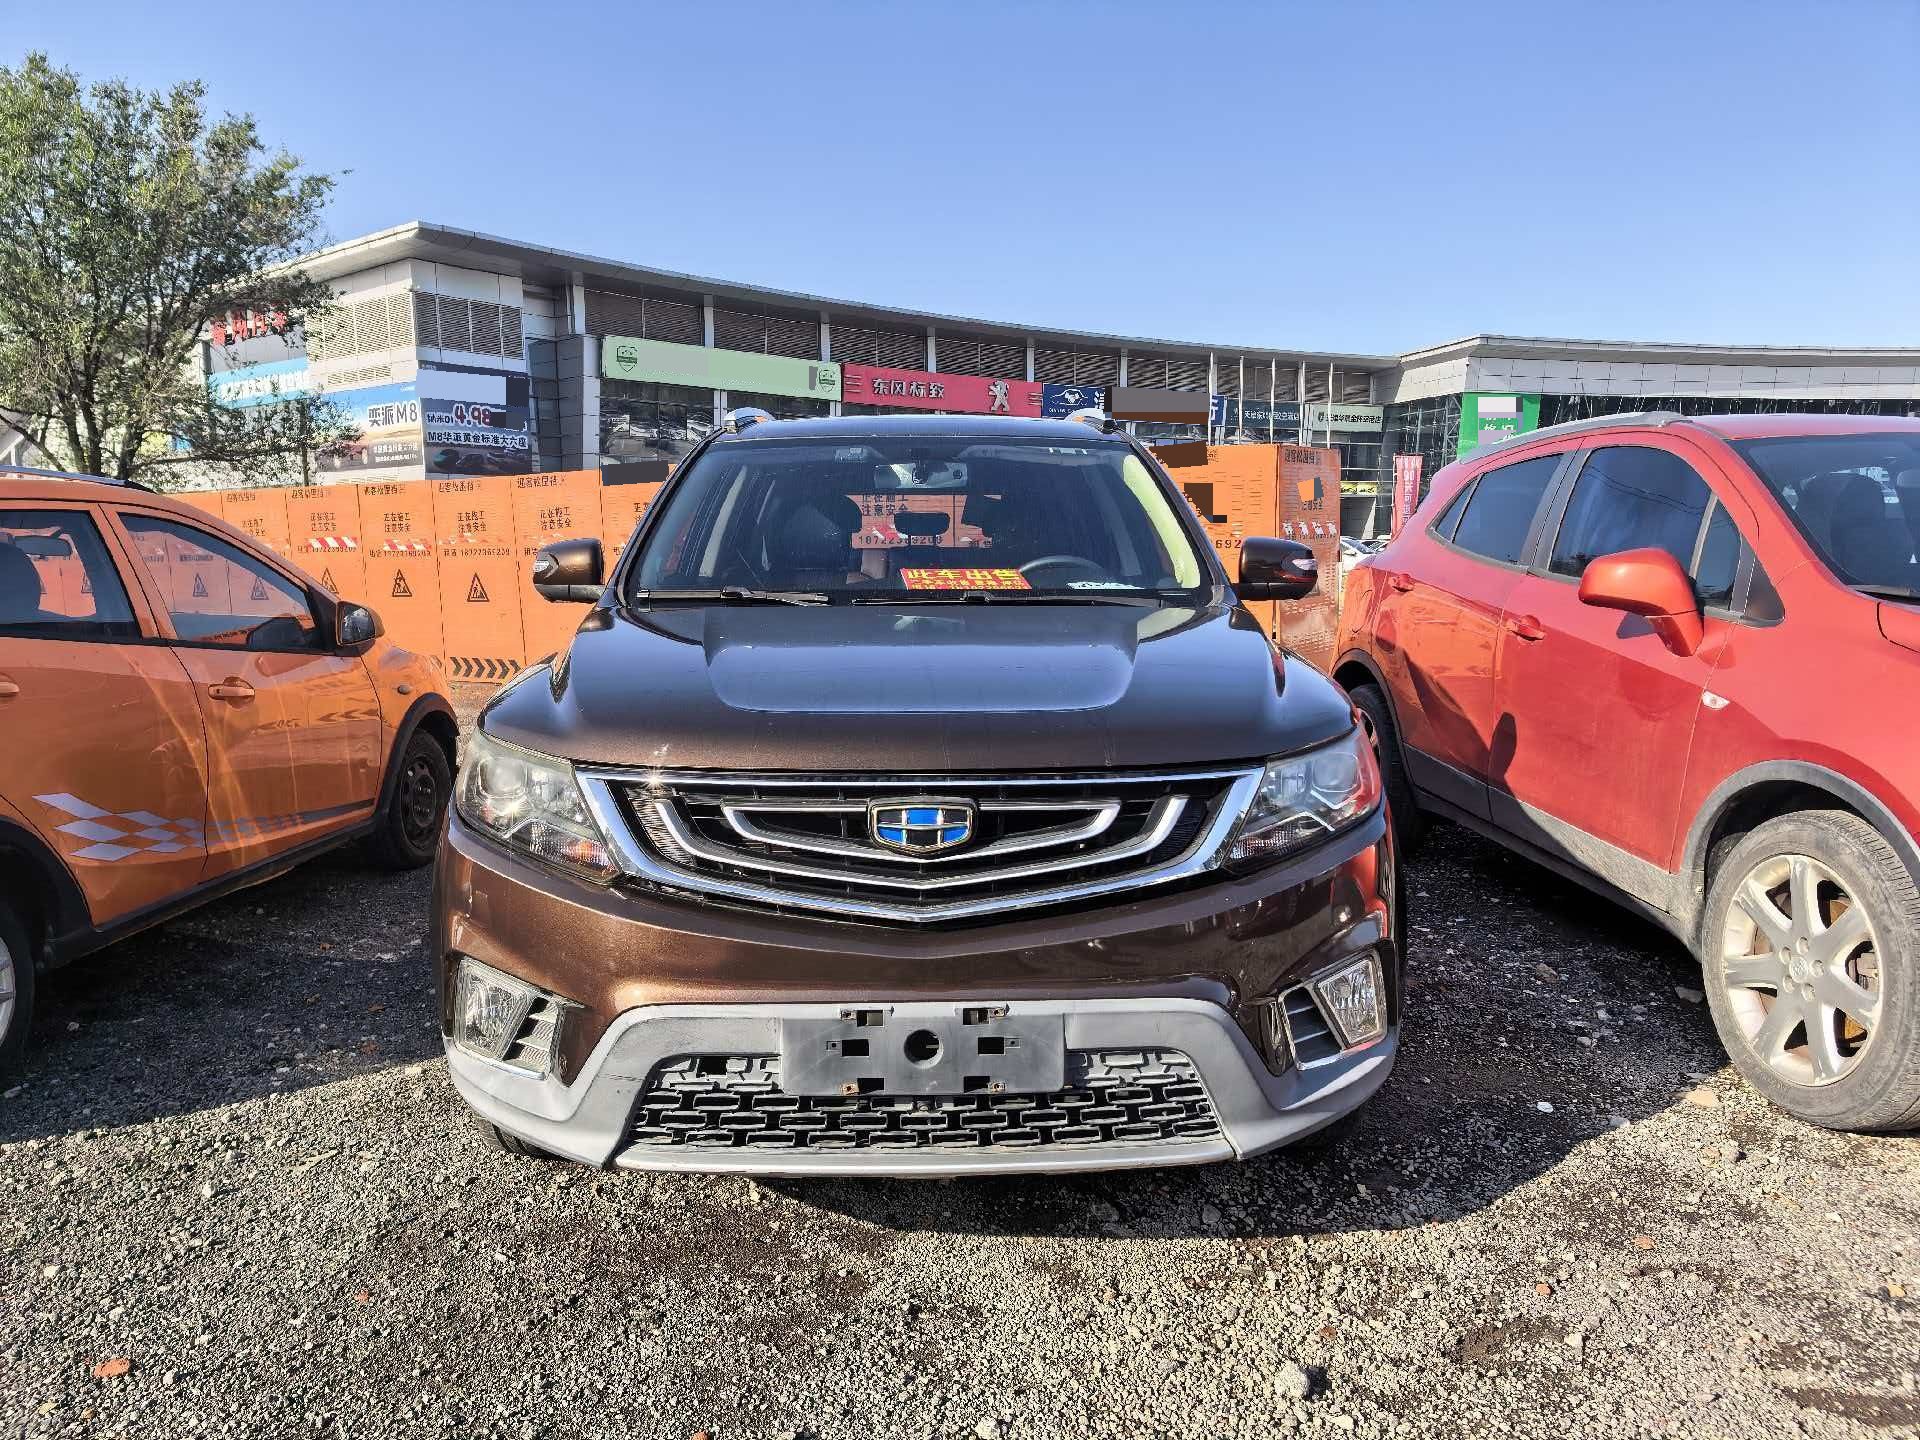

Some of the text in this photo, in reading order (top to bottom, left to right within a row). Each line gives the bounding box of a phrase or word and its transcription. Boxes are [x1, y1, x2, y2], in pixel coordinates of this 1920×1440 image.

[872, 378, 945, 399] 东风标致
[368, 402, 418, 427] 奕派M8
[862, 503, 909, 516] 注意安全
[384, 511, 411, 522] 正在施工
[457, 510, 485, 522] 正在施工
[384, 522, 411, 533] 注意安全
[458, 521, 487, 533] 注意安全
[540, 517, 572, 531] 注意安全
[907, 569, 1020, 579] 此车出售
